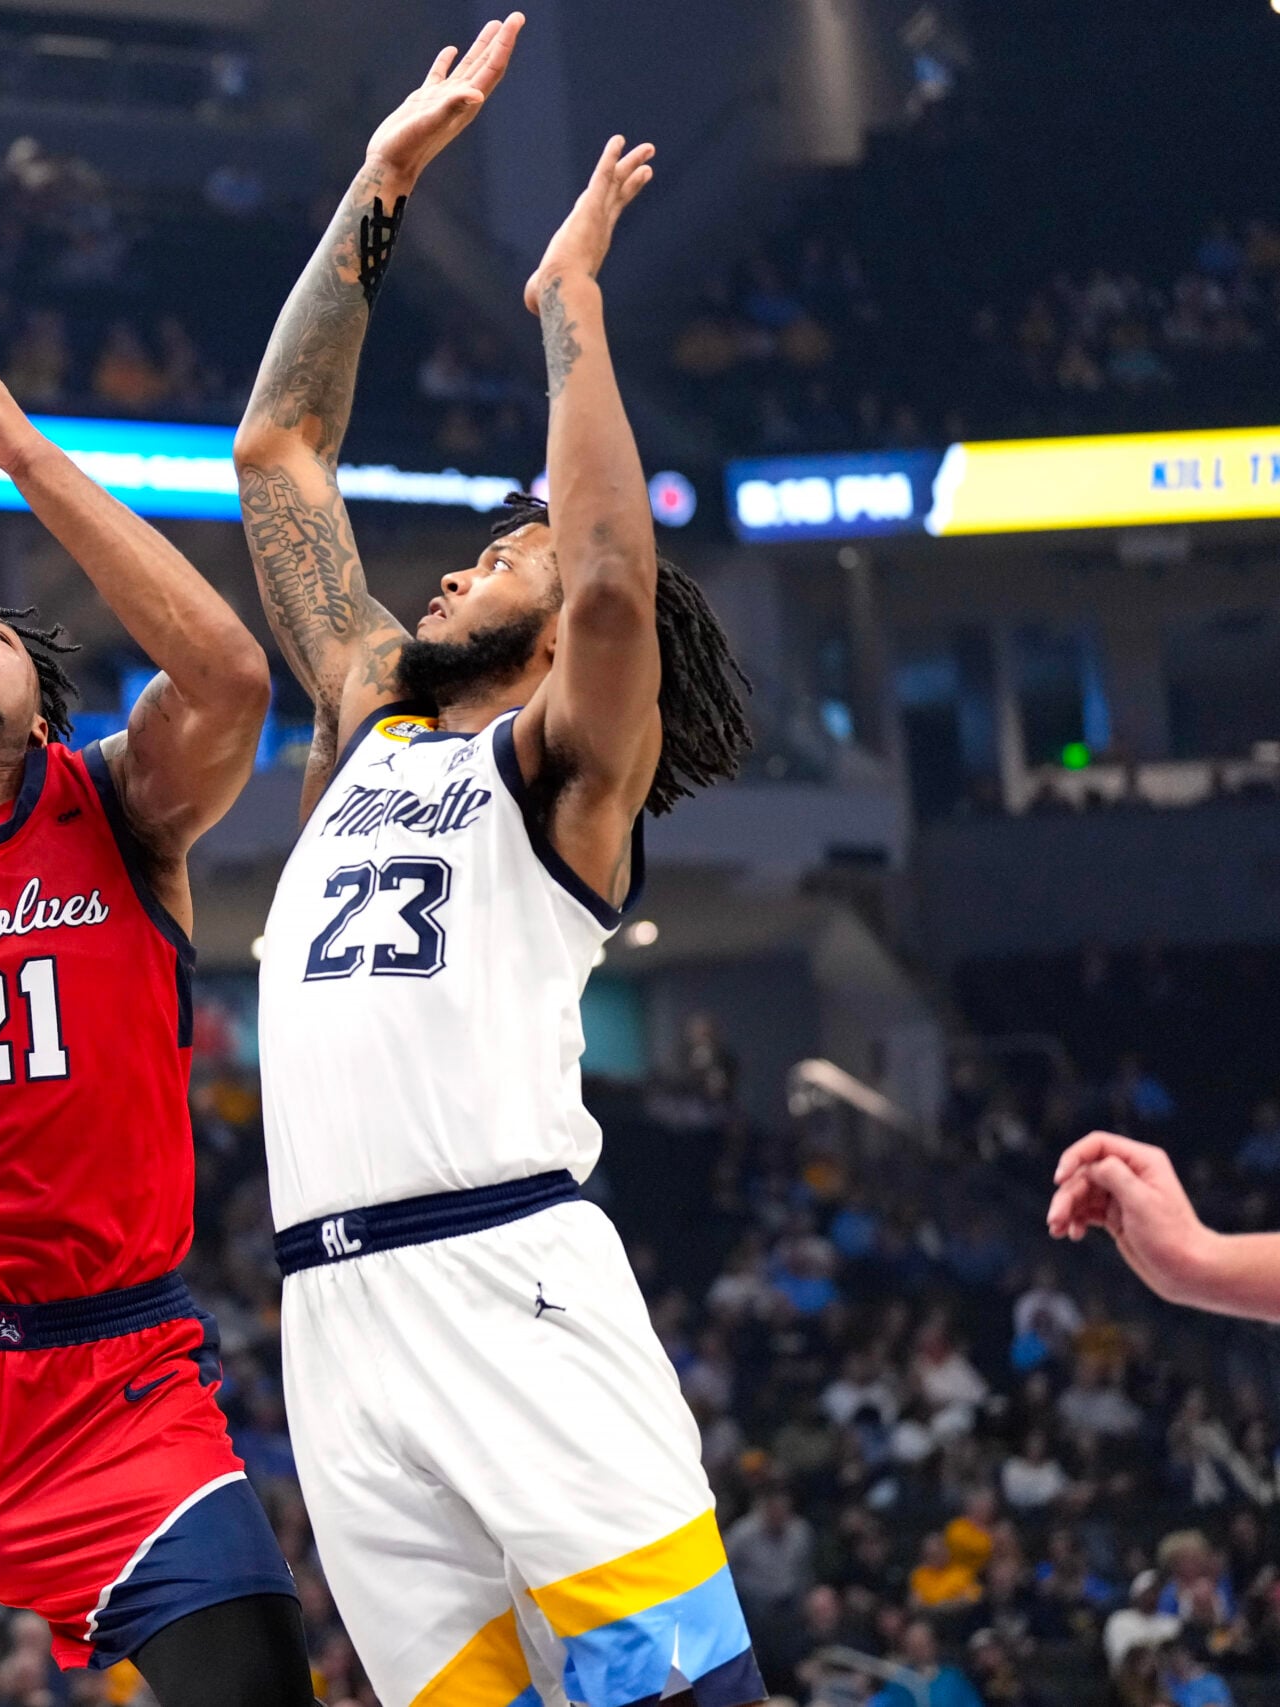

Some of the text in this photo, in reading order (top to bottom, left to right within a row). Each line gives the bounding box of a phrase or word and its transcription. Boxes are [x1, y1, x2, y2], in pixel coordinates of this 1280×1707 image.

[287, 507, 358, 634] Beauty
[303, 564, 319, 606] The
[302, 855, 452, 983] 23
[321, 1218, 362, 1258] AL
